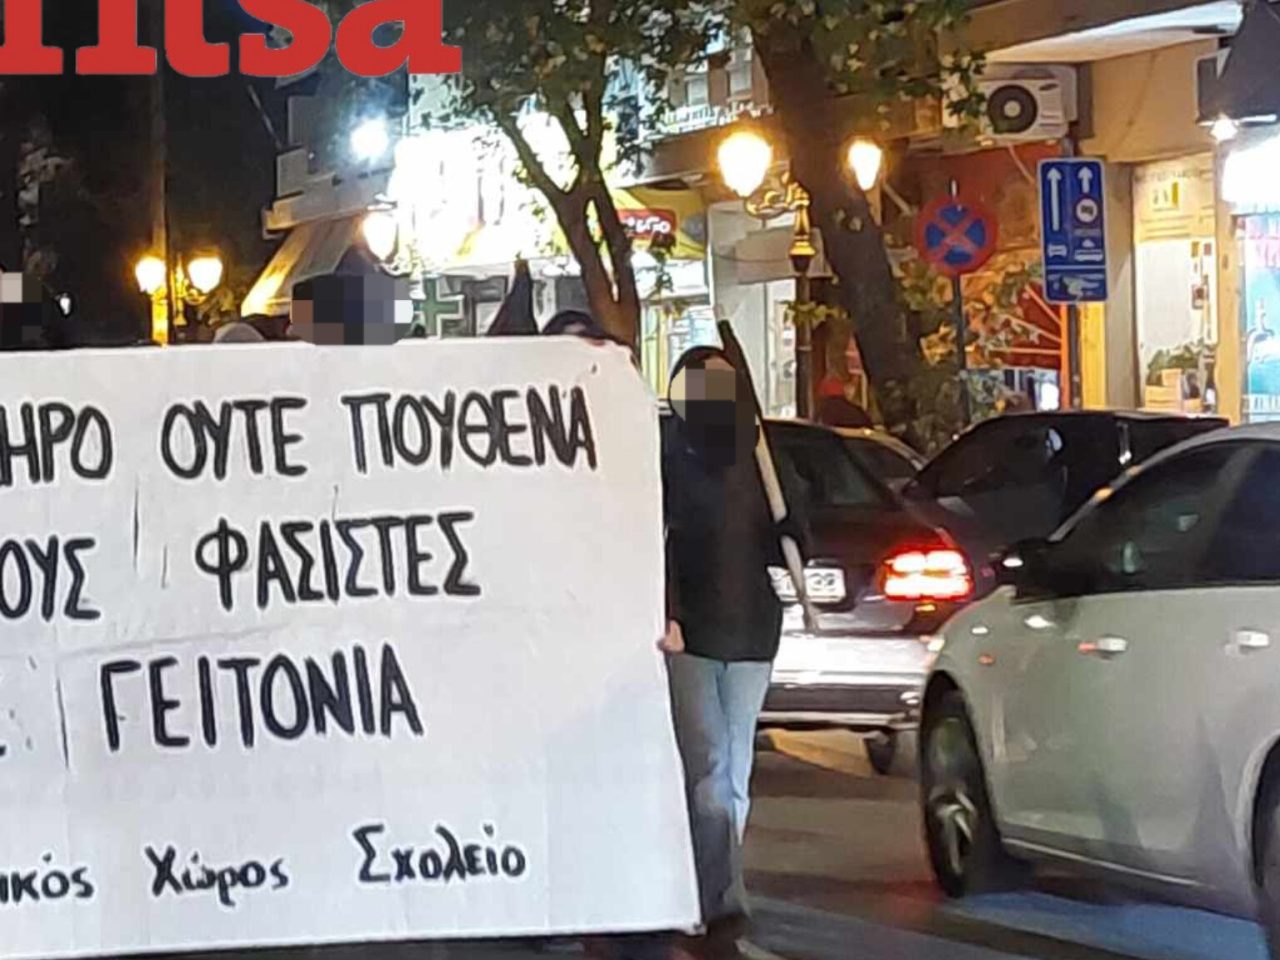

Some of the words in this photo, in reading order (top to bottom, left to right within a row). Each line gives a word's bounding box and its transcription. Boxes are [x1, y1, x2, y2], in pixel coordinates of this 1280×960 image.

[160, 397, 308, 480] ΟΥΤΕ
[194, 511, 482, 611] ΦΑΣΙΣΤΕΣ
[99, 642, 424, 752] ΓΕΙΤΟΝΙΑ
[145, 845, 290, 907] Χώρος
[352, 823, 527, 884] Σχολείο
